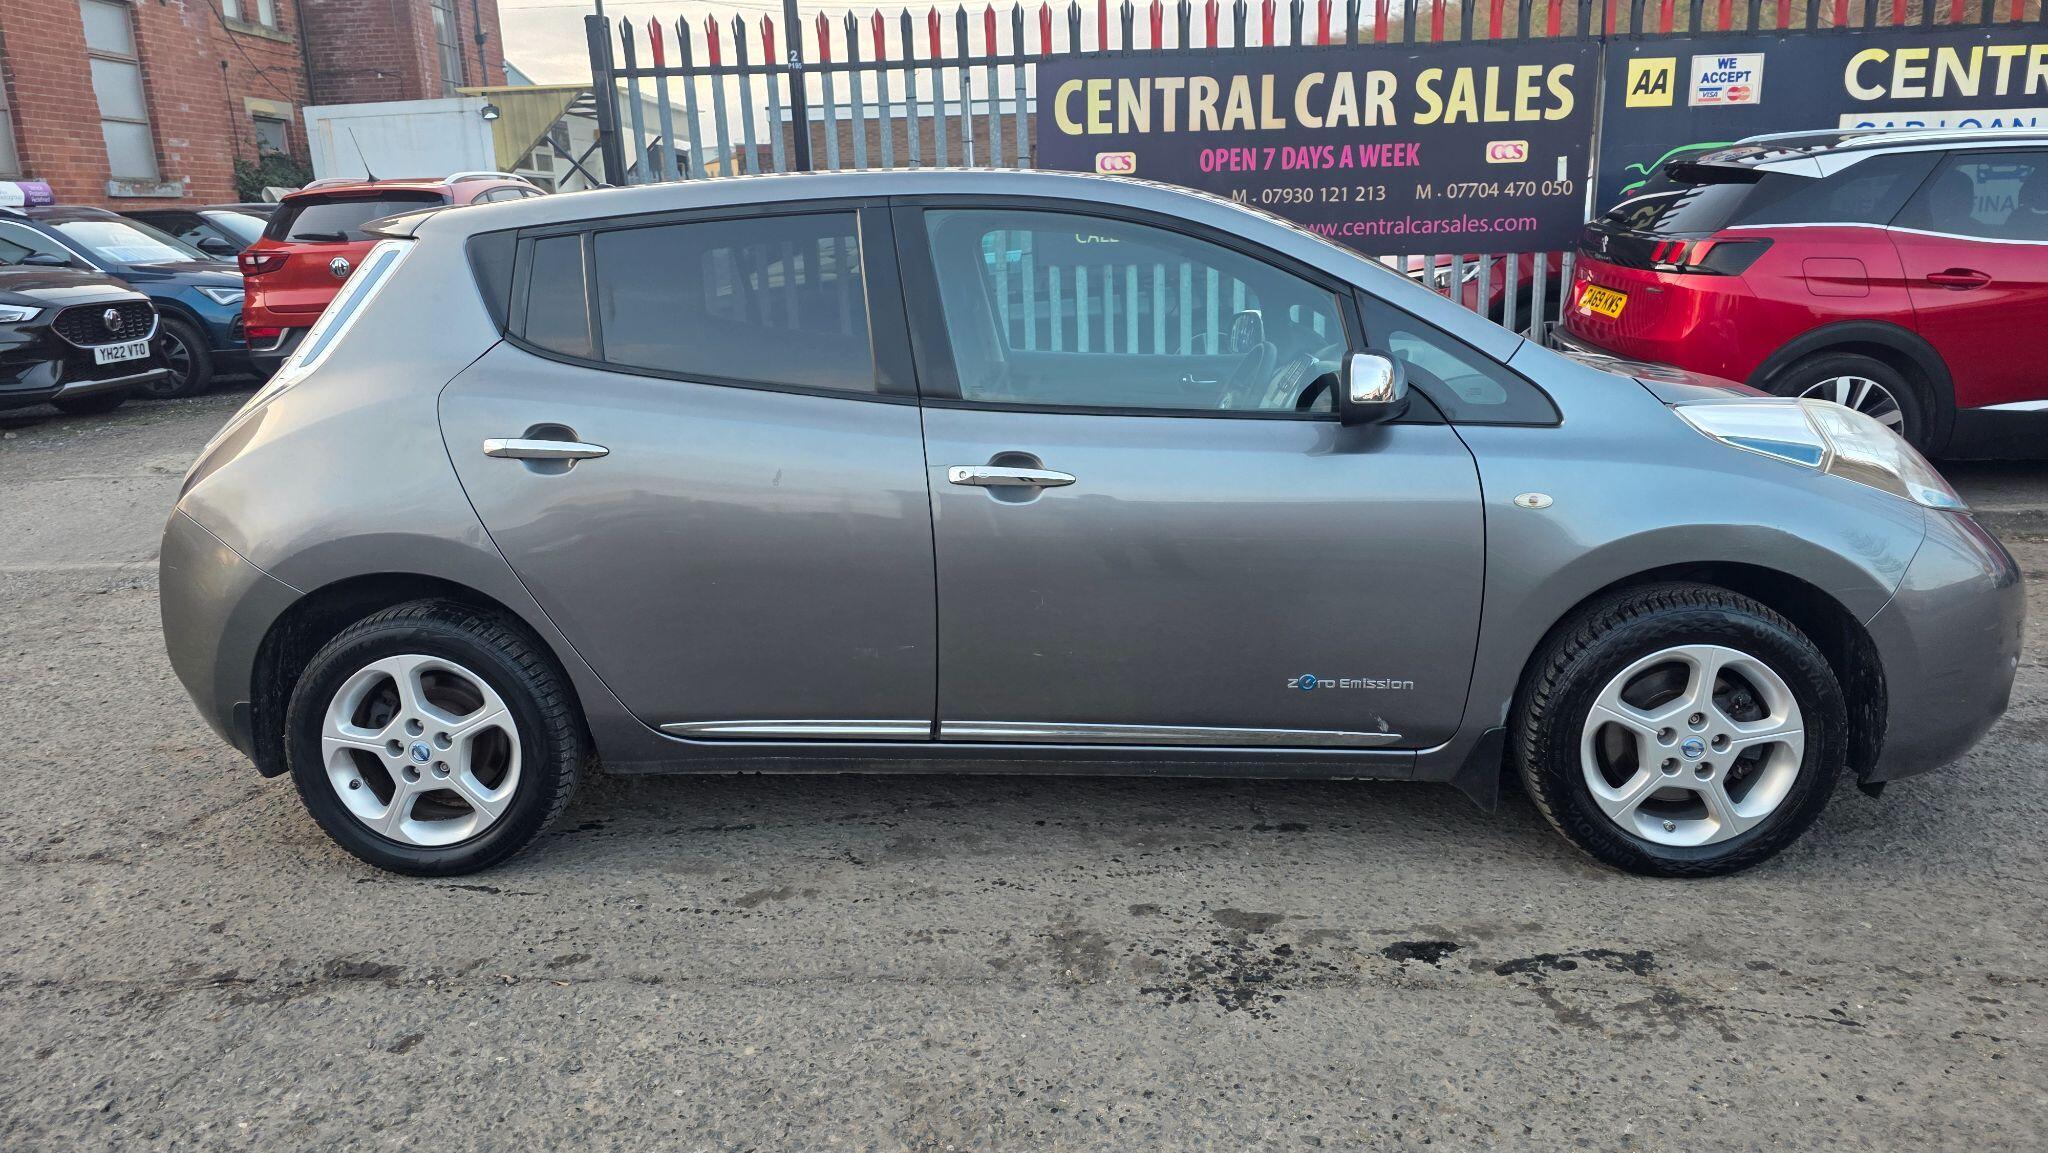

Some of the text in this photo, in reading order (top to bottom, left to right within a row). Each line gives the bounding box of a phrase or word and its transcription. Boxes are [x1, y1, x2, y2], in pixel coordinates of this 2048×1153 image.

[790, 50, 798, 62] 2
[1717, 58, 1737, 70] WE
[1631, 69, 1669, 96] AA
[1700, 71, 1751, 84] ACCEPT
[1054, 63, 1575, 135] CENTRAL CAR SALES
[1200, 143, 1421, 173] OPEN 7 DAYS A WEEK
[1262, 188, 1314, 204] 07930
[1320, 187, 1347, 202] 121
[1355, 185, 1386, 201] 213
[1447, 182, 1499, 199] 07704
[1504, 181, 1536, 197] 470
[1541, 180, 1573, 196] 050
[1302, 213, 1537, 238] ww.centralcarsales.com
[100, 343, 146, 361] YH22 VTO
[1340, 678, 1414, 690] Emission
